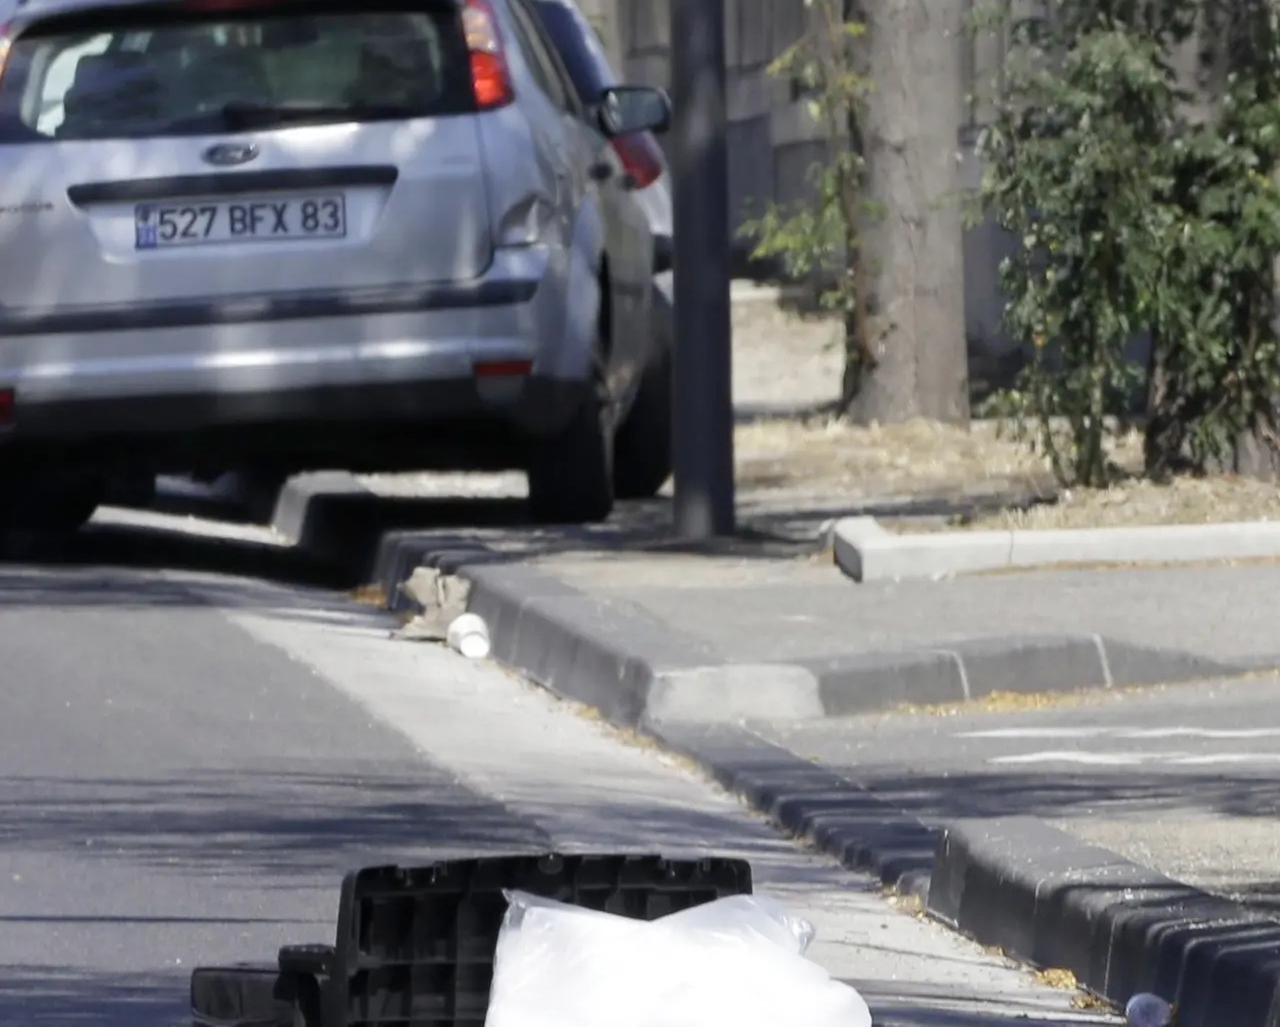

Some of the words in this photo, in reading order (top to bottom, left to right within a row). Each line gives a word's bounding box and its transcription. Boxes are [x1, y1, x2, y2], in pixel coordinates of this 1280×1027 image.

[159, 207, 218, 240] 527
[229, 203, 288, 235] BFX
[301, 199, 341, 232] 83
